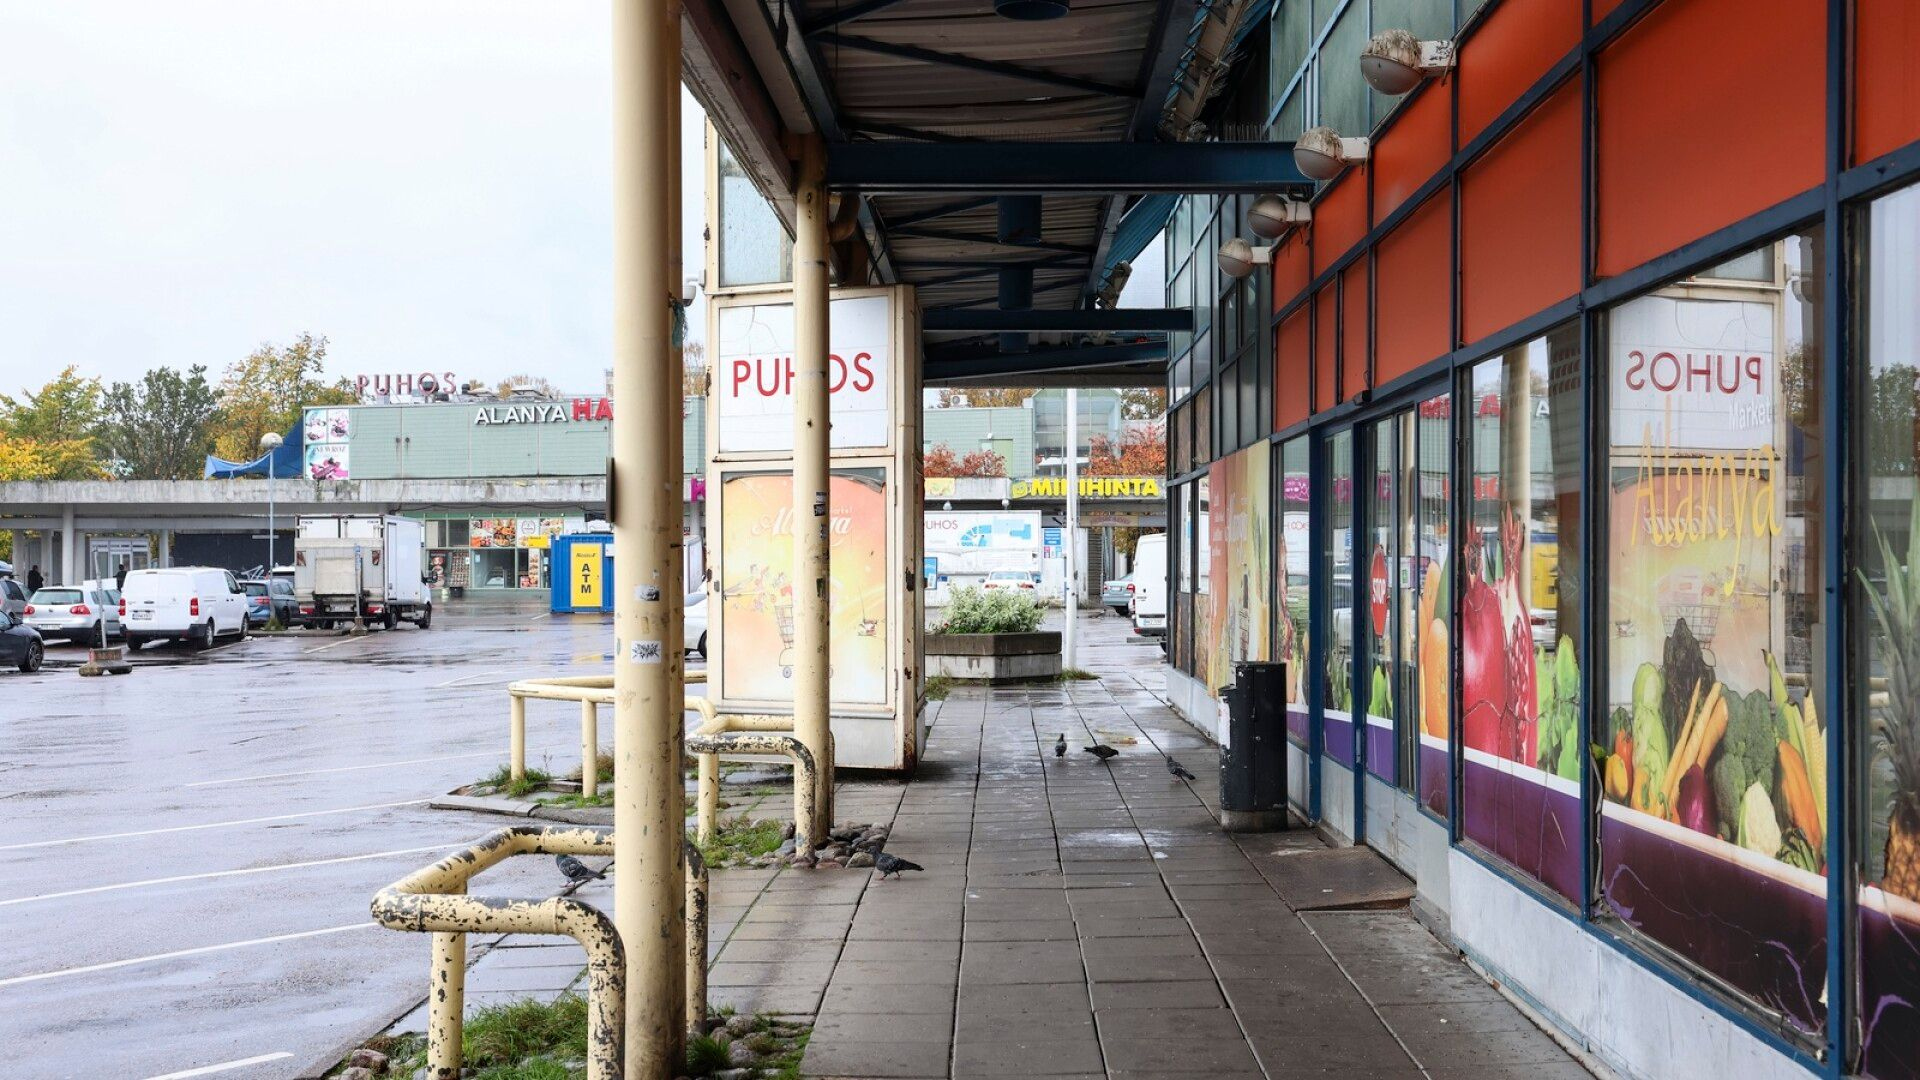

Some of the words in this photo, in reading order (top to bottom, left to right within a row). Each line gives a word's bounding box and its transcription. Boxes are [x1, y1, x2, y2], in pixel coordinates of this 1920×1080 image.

[356, 372, 457, 396] PUHOS
[474, 405, 568, 425] ALANYA
[1728, 400, 1771, 432] Market
[1631, 394, 1782, 597] Alanya
[925, 519, 958, 530] UHOS
[581, 563, 592, 594] ATM
[1372, 577, 1387, 605] STOP
